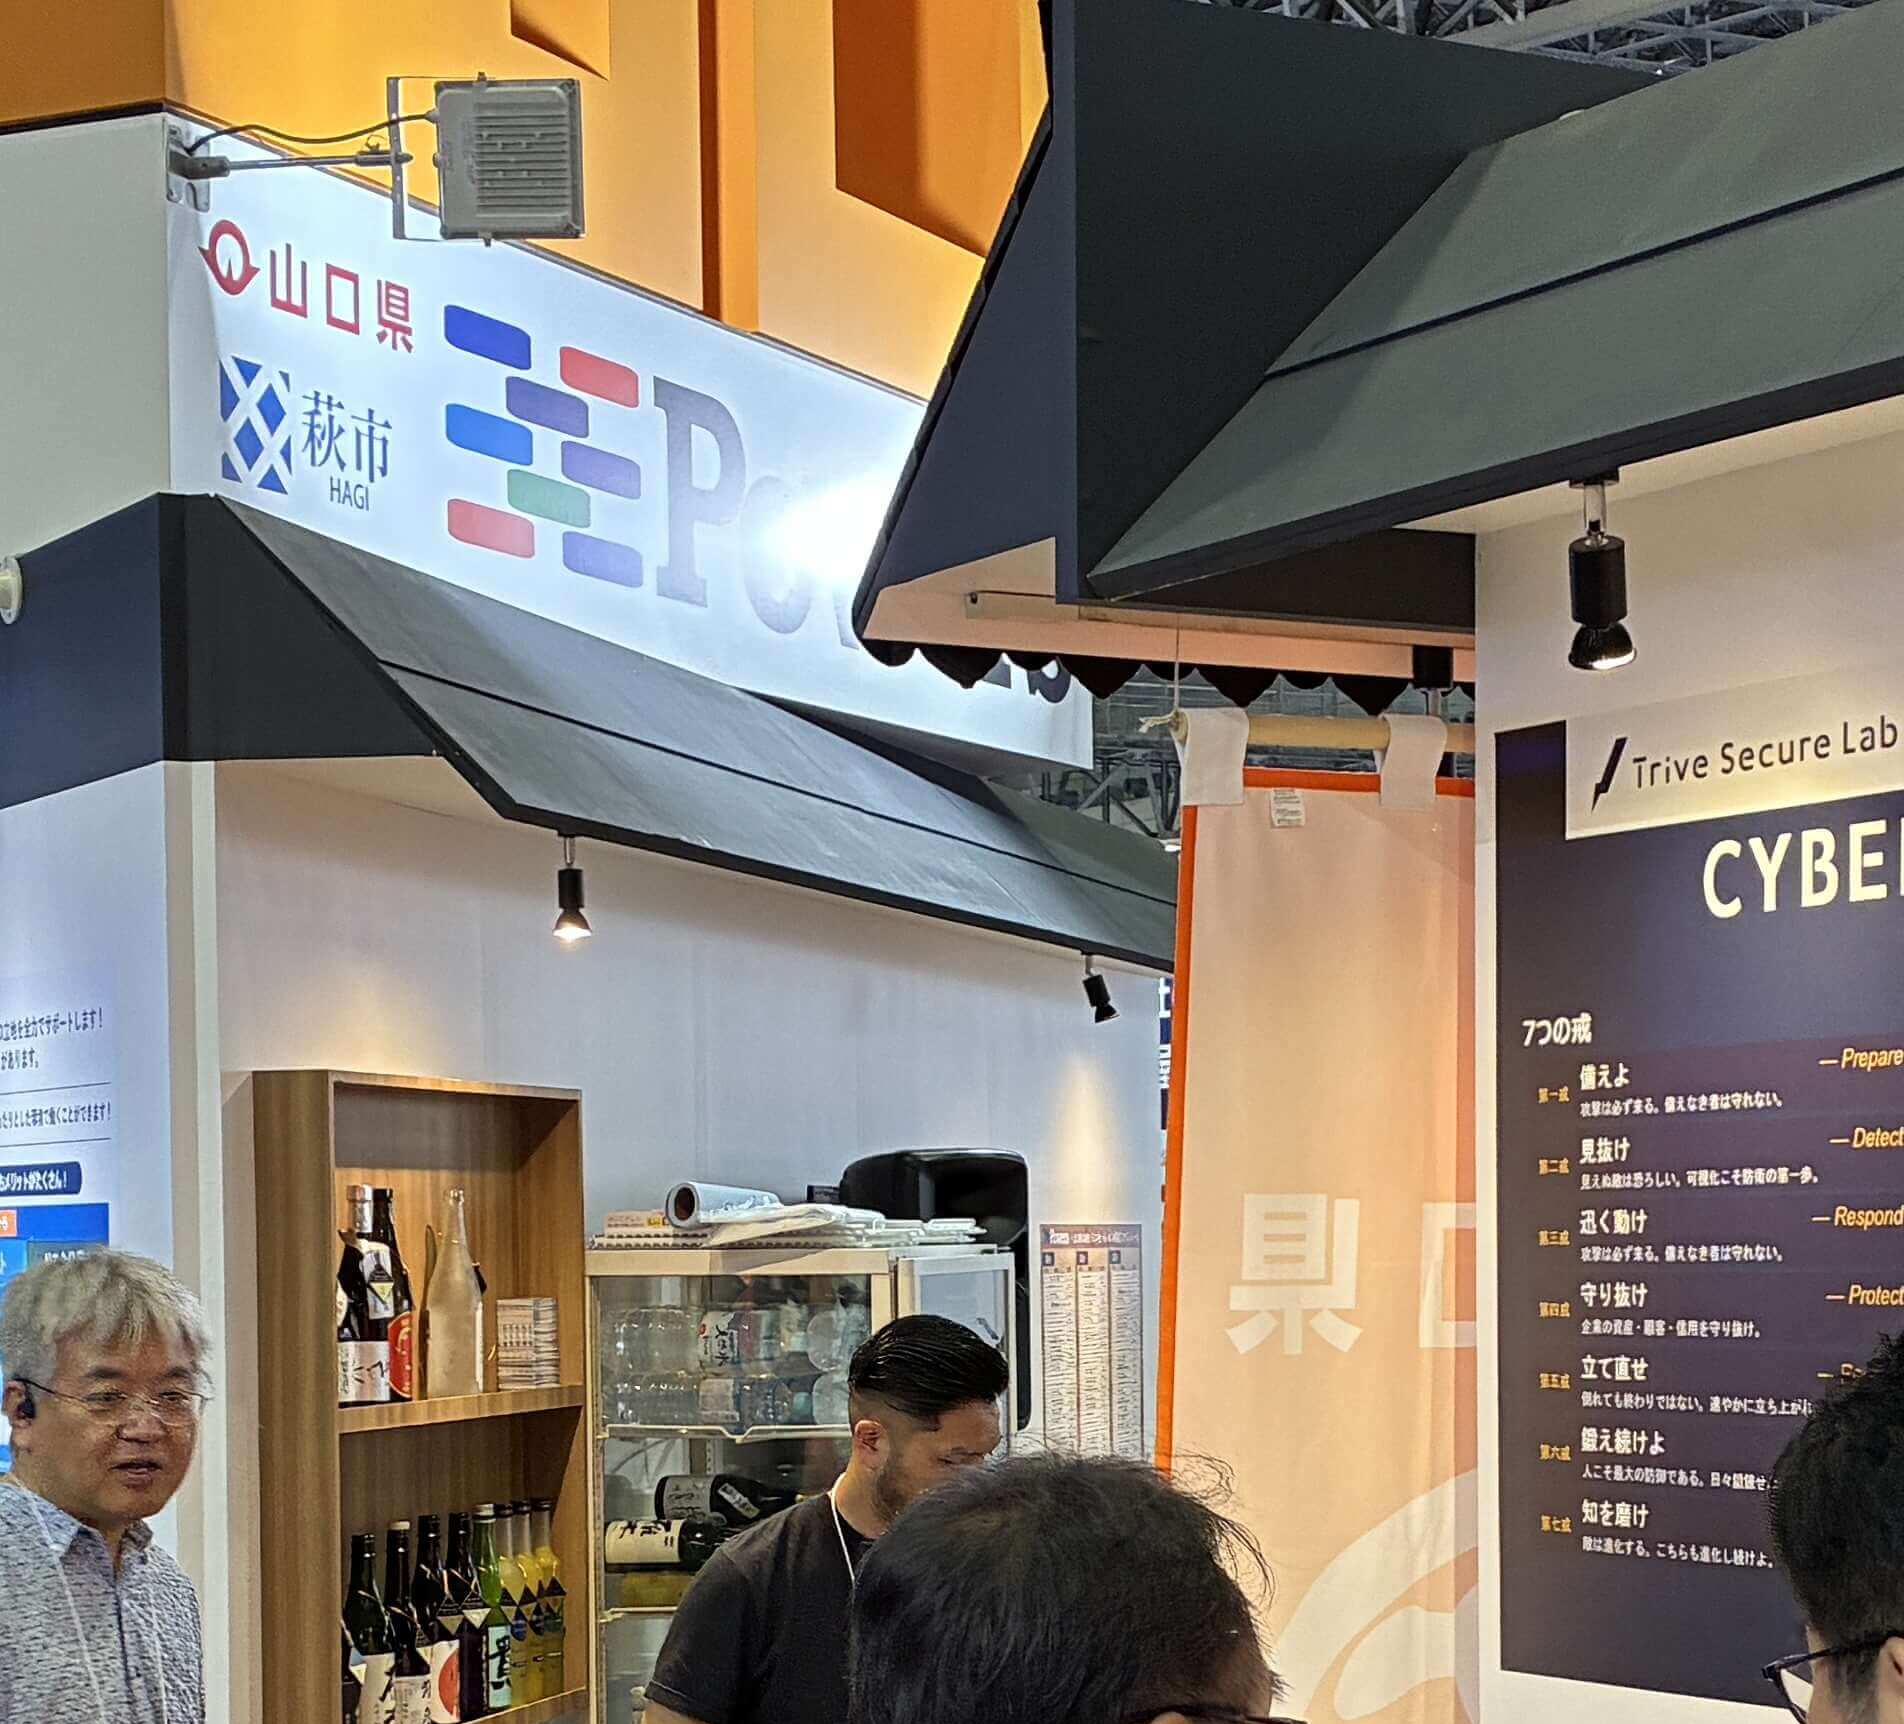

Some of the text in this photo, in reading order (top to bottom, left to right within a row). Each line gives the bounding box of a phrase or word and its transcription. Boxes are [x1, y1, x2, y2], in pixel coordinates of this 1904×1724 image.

[271, 243, 413, 353] 山口県
[302, 390, 391, 484] 萩市
[329, 475, 369, 511] HAGI
[1633, 715, 1898, 789] Trive Secure Lab
[1523, 1013, 1592, 1047] 7つの戒
[1842, 1048, 1904, 1071] Prepare
[1580, 1063, 1630, 1091] 備えよ
[1580, 1137, 1630, 1164] 見抜け
[1852, 1127, 1904, 1149] Detect
[1579, 1209, 1647, 1236] 迅く動け
[1834, 1205, 1904, 1230] Respond
[1580, 1282, 1647, 1309] 守り抜け
[1849, 1285, 1904, 1306] Protect
[1580, 1354, 1648, 1381] 立て直せ
[1581, 1427, 1665, 1456] 鍛え続けよ
[1581, 1499, 1649, 1529] 知を磨け
